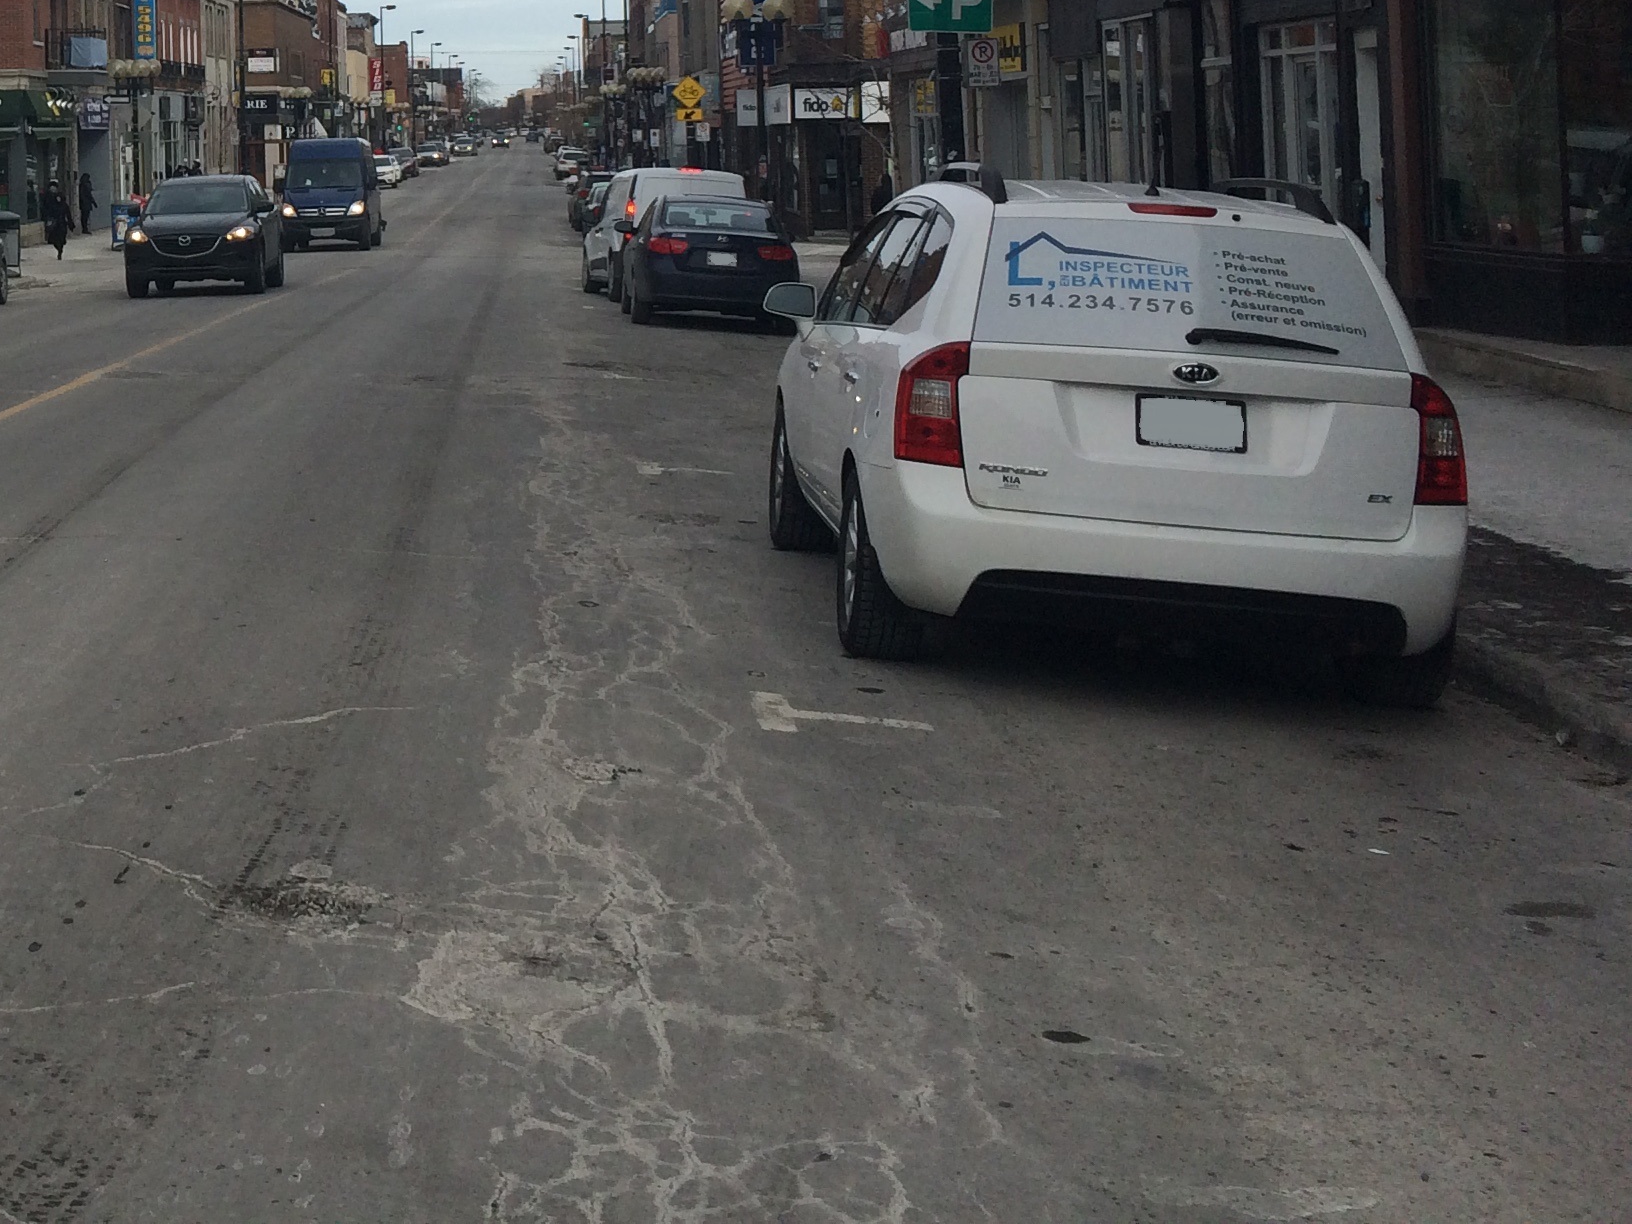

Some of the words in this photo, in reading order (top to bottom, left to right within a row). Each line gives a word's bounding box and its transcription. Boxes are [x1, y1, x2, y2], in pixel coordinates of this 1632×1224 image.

[803, 97, 829, 113] fido
[1222, 250, 1287, 266] Pré-achat
[1059, 260, 1190, 277] INSPECTEUR
[1224, 262, 1289, 278] Pré-vente
[1071, 273, 1193, 293] BÂTIMENT
[1274, 280, 1316, 293] neuve
[1008, 293, 1195, 316] 514.234.7576
[1228, 286, 1326, 307] Pré-Réception
[1230, 299, 1305, 316] Assurance
[1231, 310, 1279, 325] (erreur
[1282, 317, 1297, 327] et
[1300, 320, 1367, 338] omission)
[1002, 475, 1021, 485] KIA
[1367, 494, 1393, 504] EX
